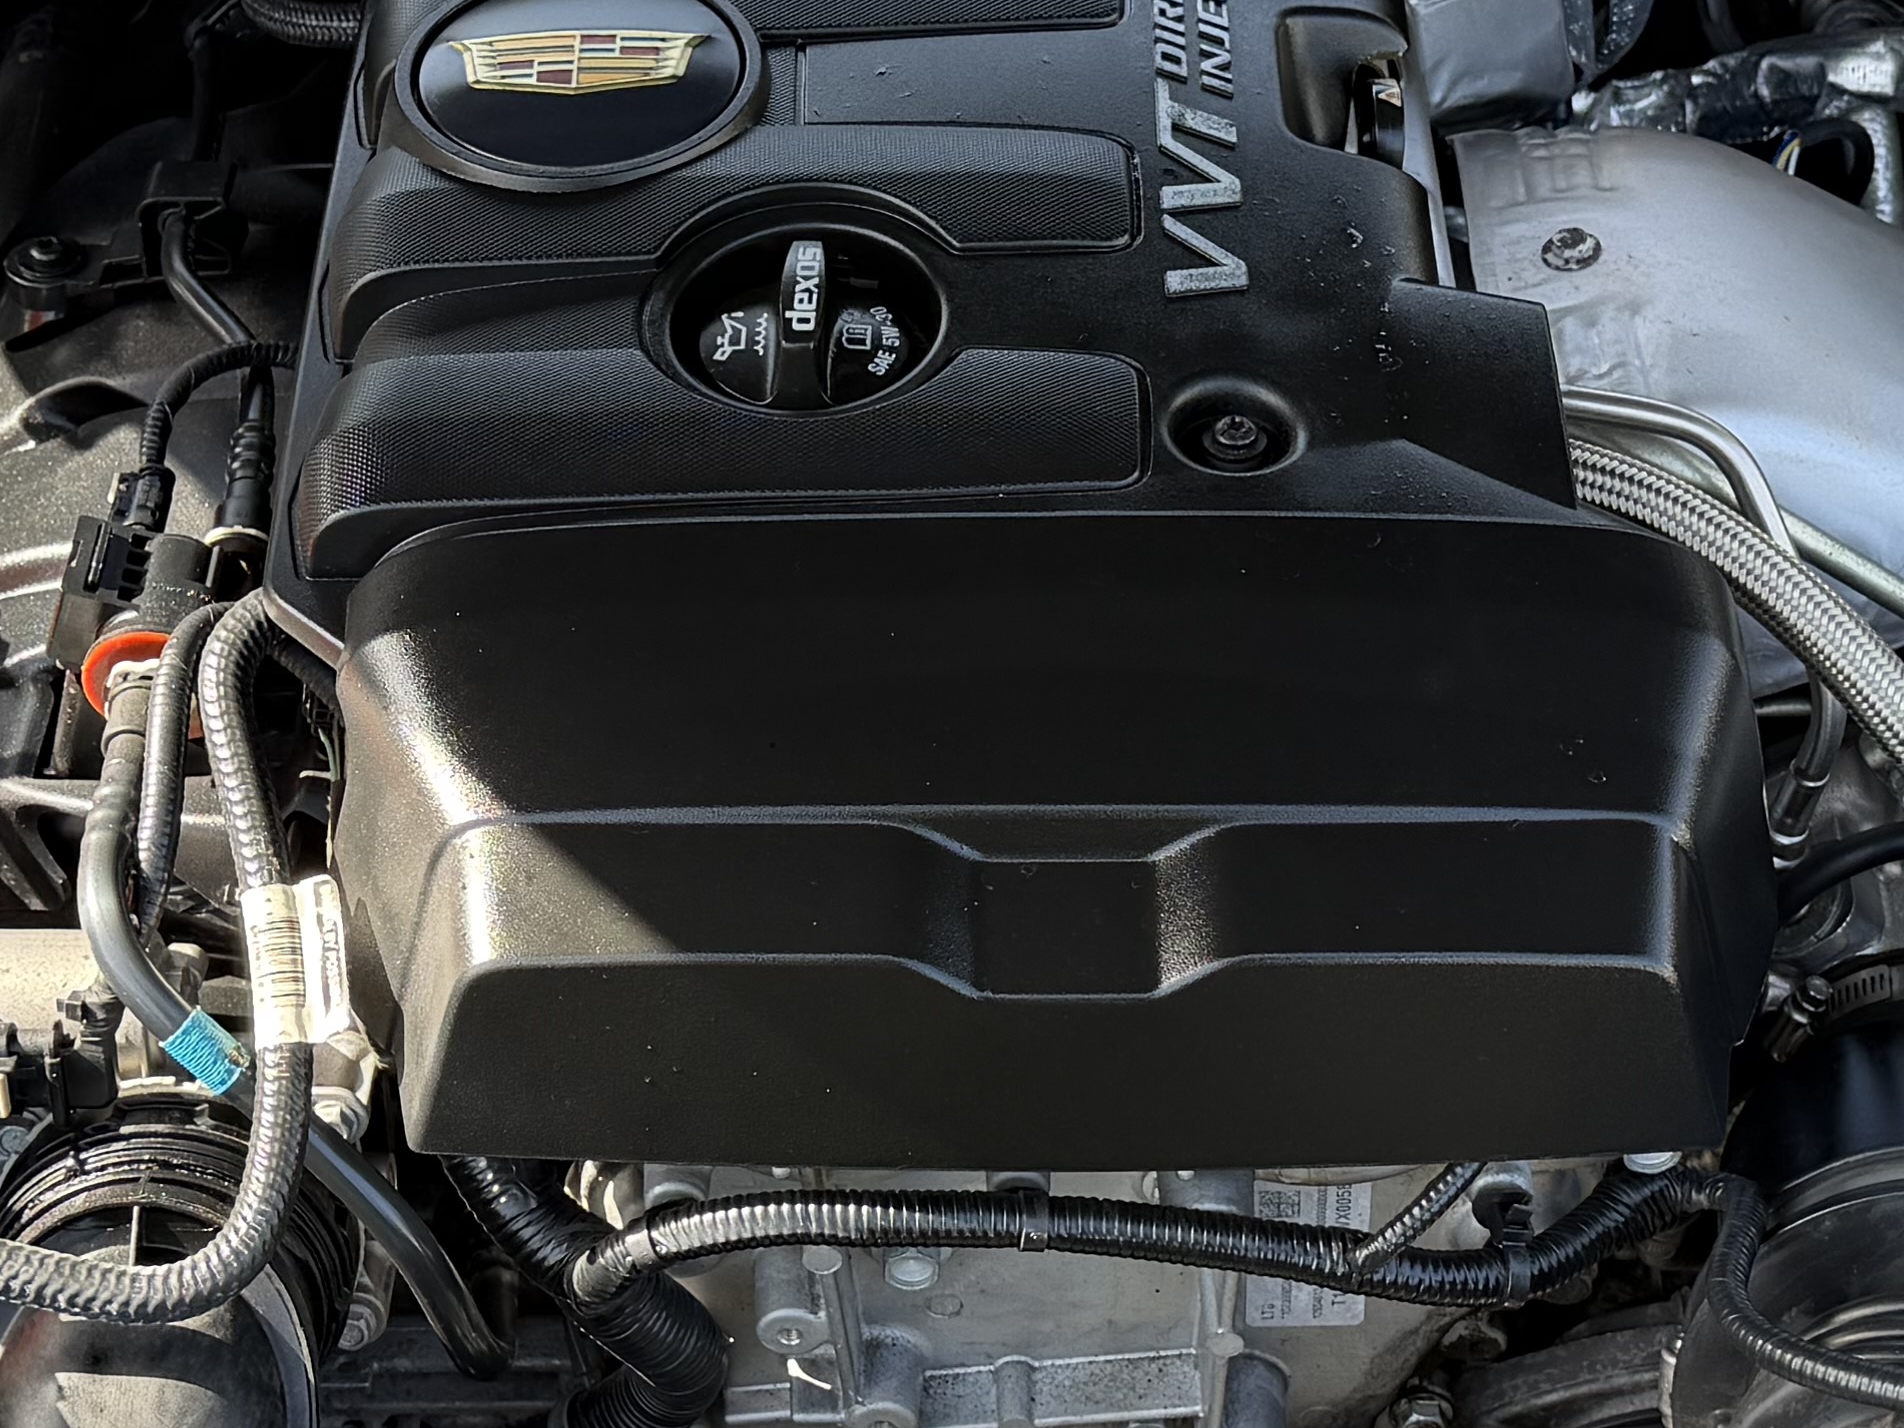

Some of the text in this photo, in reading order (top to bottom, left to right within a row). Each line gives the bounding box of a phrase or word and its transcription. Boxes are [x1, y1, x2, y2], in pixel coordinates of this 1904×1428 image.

[1154, 77, 1250, 297] VVT
[785, 246, 821, 332] dexos
[868, 306, 901, 376] SAE 5W-30
